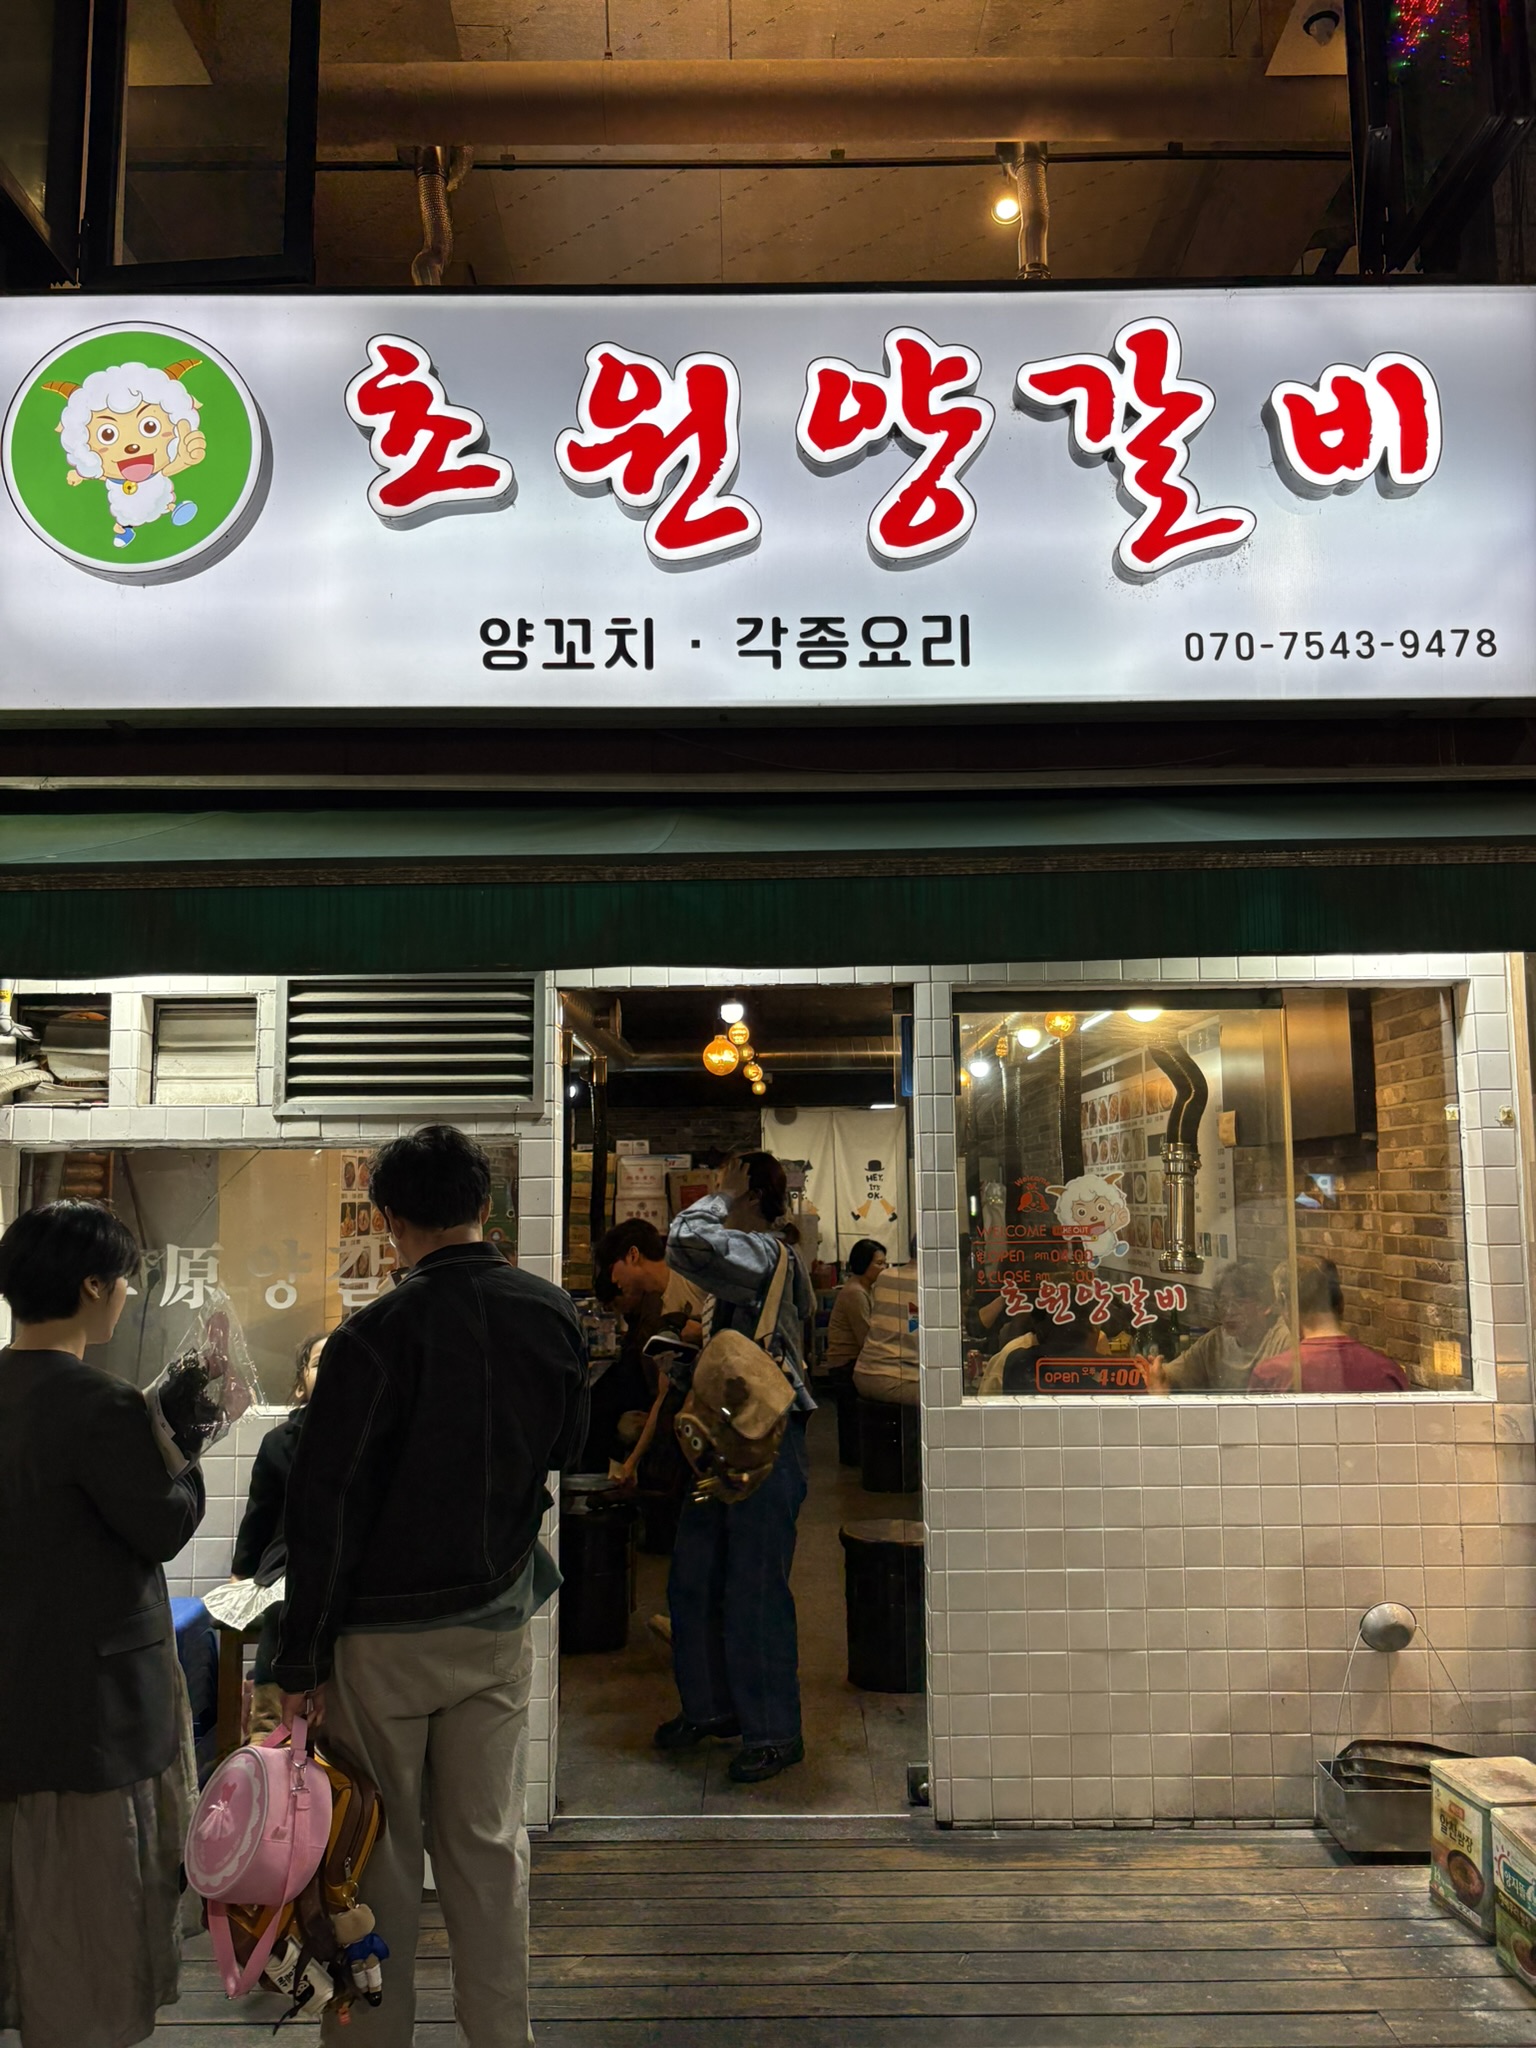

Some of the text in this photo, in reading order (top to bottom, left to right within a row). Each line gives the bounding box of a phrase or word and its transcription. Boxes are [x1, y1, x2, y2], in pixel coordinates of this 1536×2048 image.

[346, 318, 1442, 573] 초원양갈비
[479, 616, 655, 671] 양꼬치
[735, 614, 971, 670] 각종요리
[1184, 628, 1498, 662] 070-7543-9478
[977, 1224, 1047, 1238] WELCOME
[1072, 1226, 1089, 1235] OUT
[988, 1250, 1025, 1263] OPEN
[989, 1270, 1031, 1283] CLOSE
[1001, 1276, 1188, 1328] 초원양갈비
